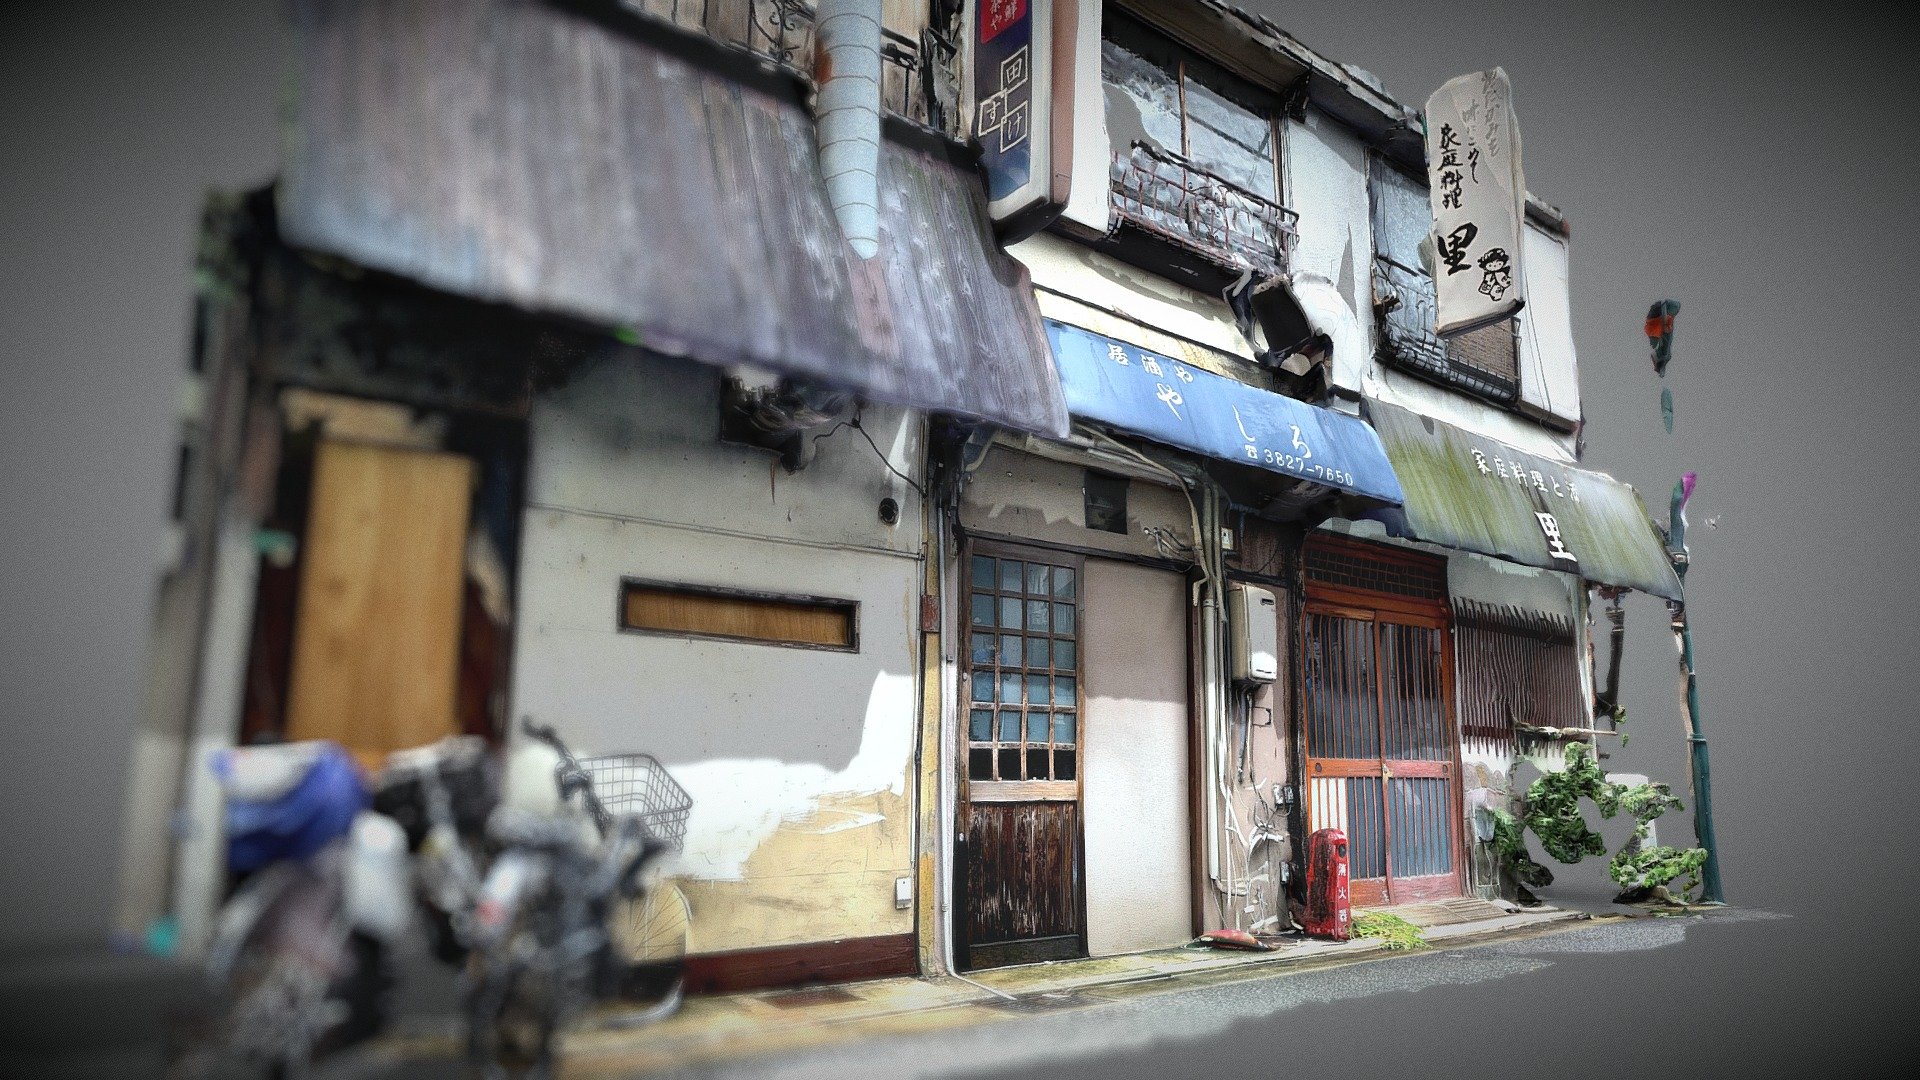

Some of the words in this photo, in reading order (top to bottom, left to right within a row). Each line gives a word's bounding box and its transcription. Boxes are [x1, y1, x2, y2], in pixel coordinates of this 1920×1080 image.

[1437, 123, 1464, 209] 家庭料理
[1437, 222, 1478, 276] 里
[1107, 343, 1194, 385] 居酒や
[1263, 448, 1354, 487] 3827-7650
[1533, 510, 1578, 562] 里
